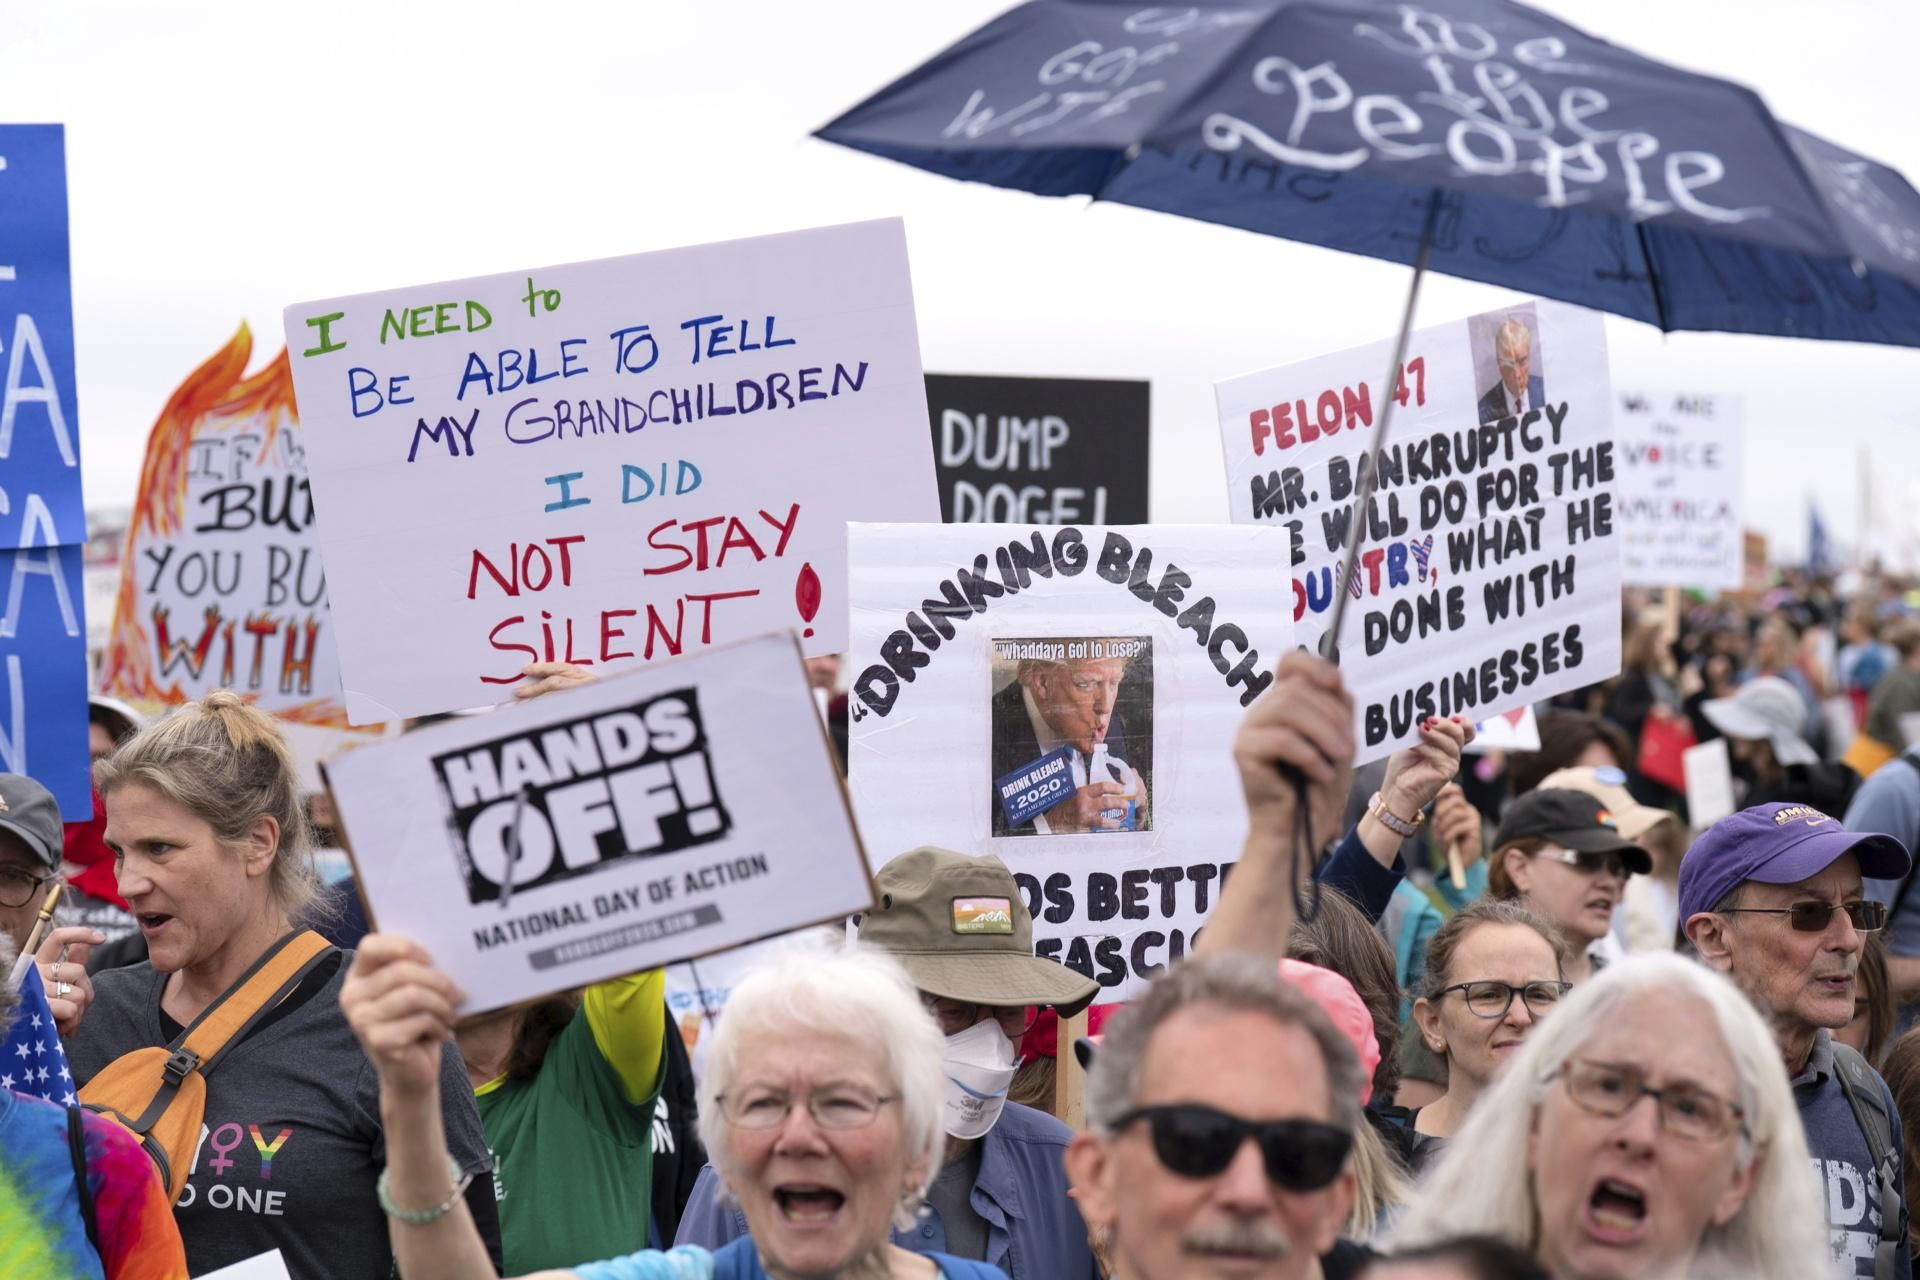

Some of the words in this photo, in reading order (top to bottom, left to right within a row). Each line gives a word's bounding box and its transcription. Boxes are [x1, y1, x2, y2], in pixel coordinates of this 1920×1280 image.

[1203, 56, 1770, 224] People
[302, 310, 348, 358] I
[379, 299, 493, 346] NEED
[521, 277, 563, 317] to
[348, 367, 416, 418] BE
[457, 338, 589, 400] ABLE
[610, 325, 658, 374] TO
[681, 314, 797, 365] TELL
[407, 408, 480, 463] MY
[504, 361, 869, 445] GRANDCHILDREN
[941, 408, 1070, 471] DUMP
[1249, 381, 1374, 456] FELON
[1250, 466, 1320, 520] MR.
[1328, 401, 1569, 503] BANKRUPTCY
[545, 471, 592, 513] I
[621, 459, 702, 505] DID
[1321, 490, 1408, 553] WILL
[1420, 480, 1468, 530] DO
[1476, 463, 1540, 518] FOR
[1548, 441, 1616, 496] THE
[143, 545, 243, 598] YOU
[265, 545, 330, 610] BU
[467, 535, 586, 599] NOT
[643, 503, 800, 576] STAY
[1291, 534, 1439, 622] OUNTRY,
[1447, 509, 1546, 576] WHAT
[1567, 492, 1614, 545] HE
[152, 600, 322, 695] WITH
[1068, 642, 1089, 659] Got
[1096, 531, 1275, 708] BLEACH
[1364, 584, 1467, 658] DONE
[1483, 555, 1578, 625] WITH
[1366, 624, 1586, 748] BUSINESSES
[441, 697, 699, 808] HANDS
[1001, 772, 1031, 800] DRINK
[1030, 757, 1066, 785] BLEACH
[1016, 778, 1062, 809] 2020
[466, 751, 722, 889] OFF!
[473, 898, 590, 953] NATIONAL
[597, 880, 647, 920] DAY
[650, 873, 680, 905] OF
[684, 853, 770, 898] ACTION
[1087, 862, 1239, 922] BETT
[1035, 928, 1204, 988] FASCI
[207, 1184, 287, 1216] ONE
